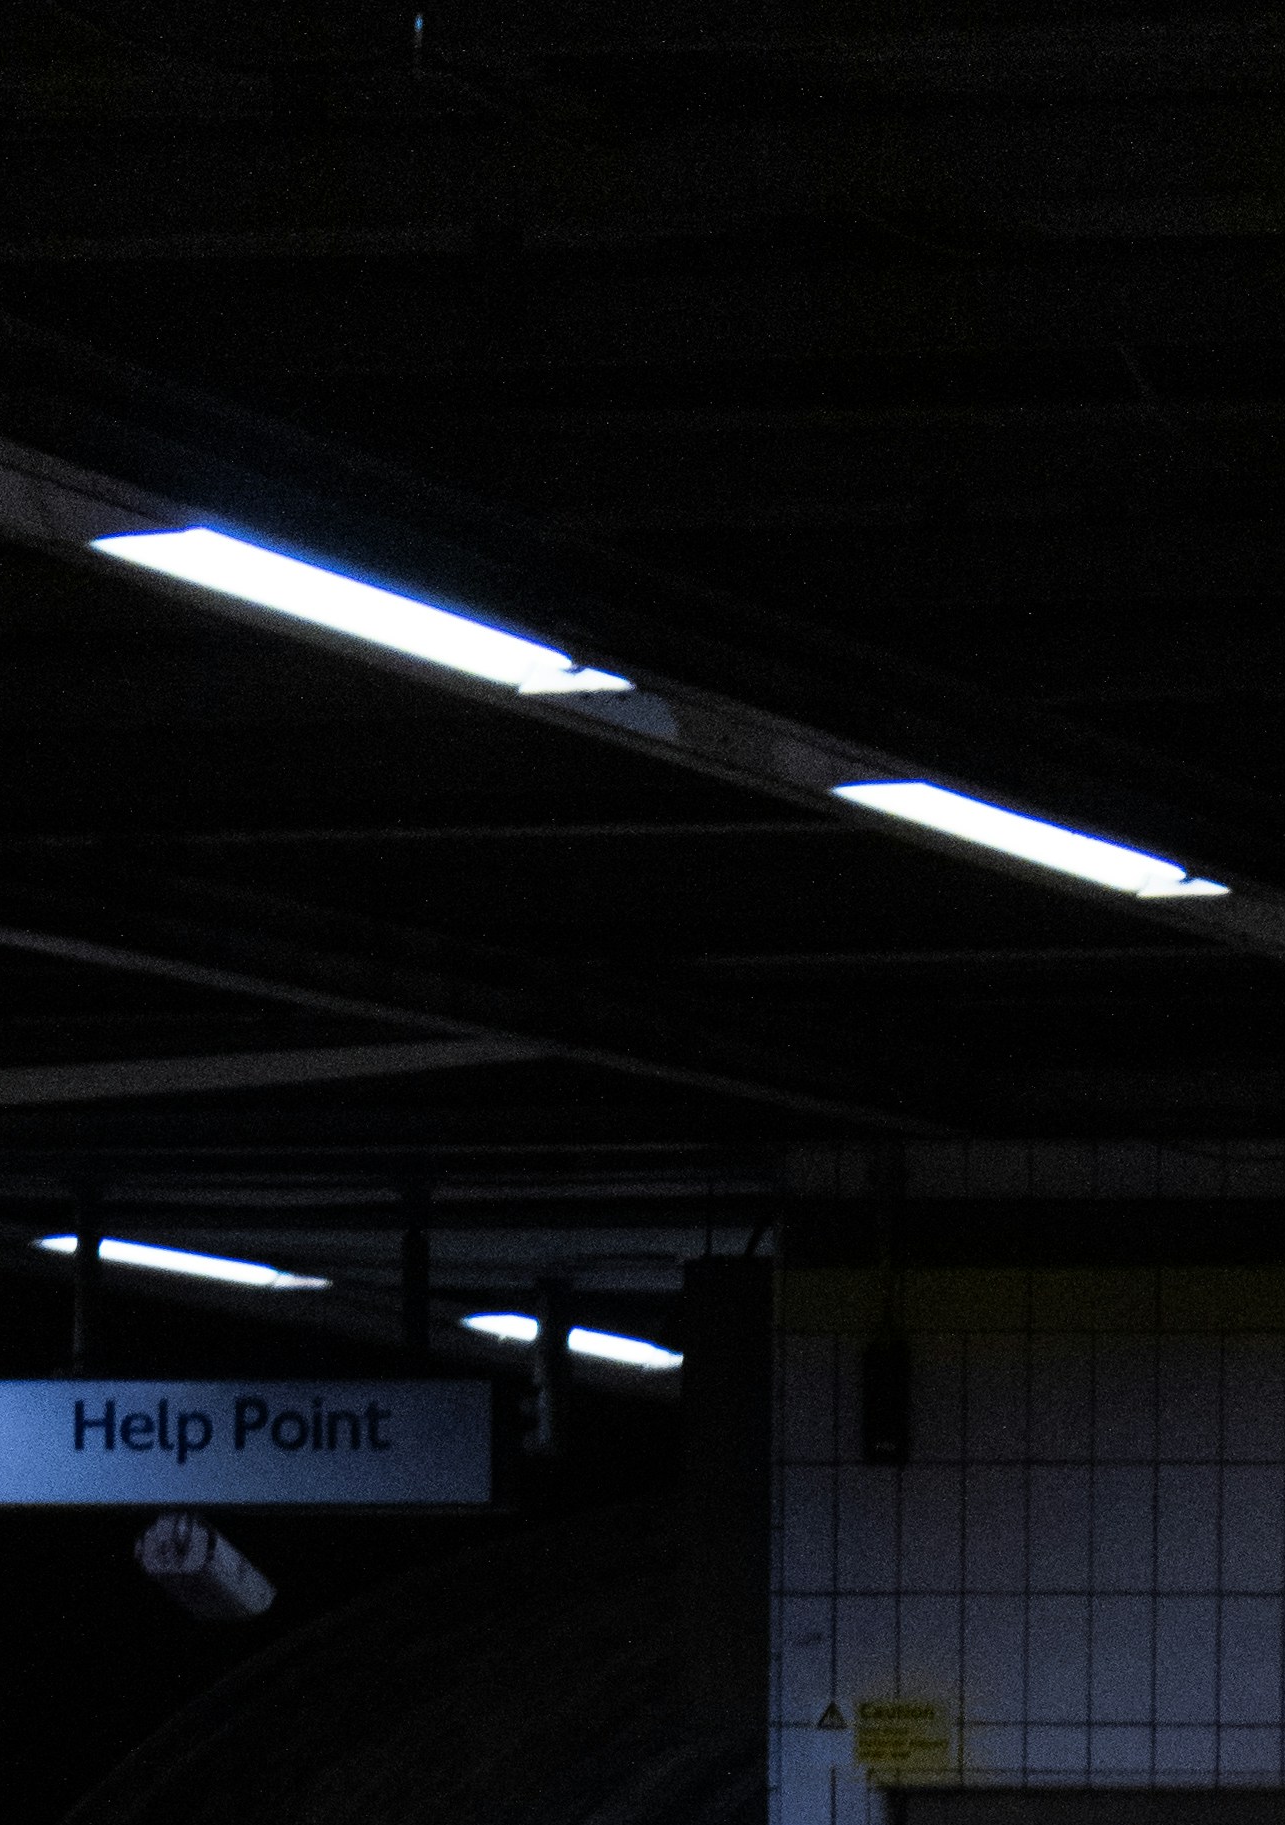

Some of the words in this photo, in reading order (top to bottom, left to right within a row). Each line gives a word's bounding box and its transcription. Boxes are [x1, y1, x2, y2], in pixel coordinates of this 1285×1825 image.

[74, 1398, 214, 1464] Help
[234, 1395, 392, 1451] Point
[859, 1702, 936, 1720] Caution
